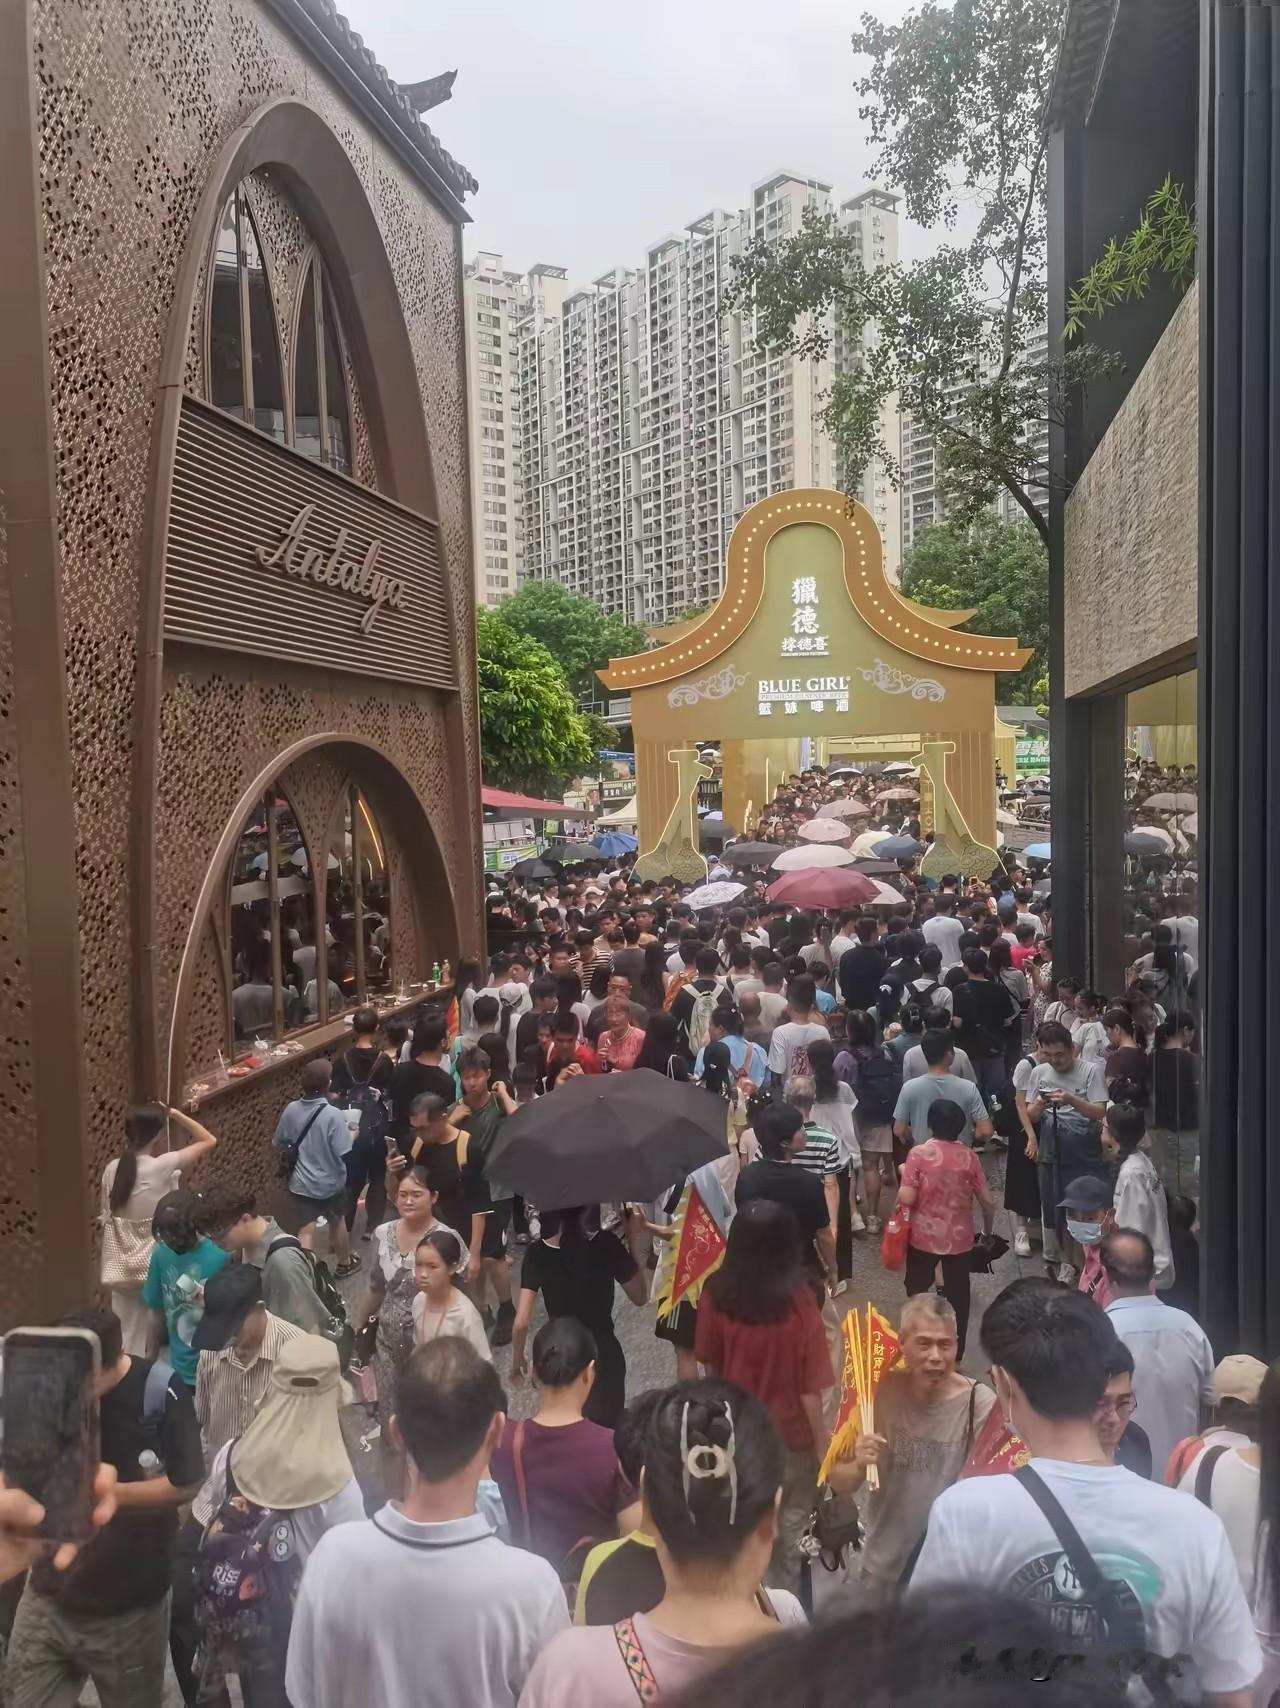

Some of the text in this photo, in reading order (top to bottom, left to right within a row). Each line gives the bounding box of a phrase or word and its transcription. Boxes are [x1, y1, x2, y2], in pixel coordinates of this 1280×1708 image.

[790, 576, 820, 634] 獵德
[758, 676, 849, 694] BLUE GIRL
